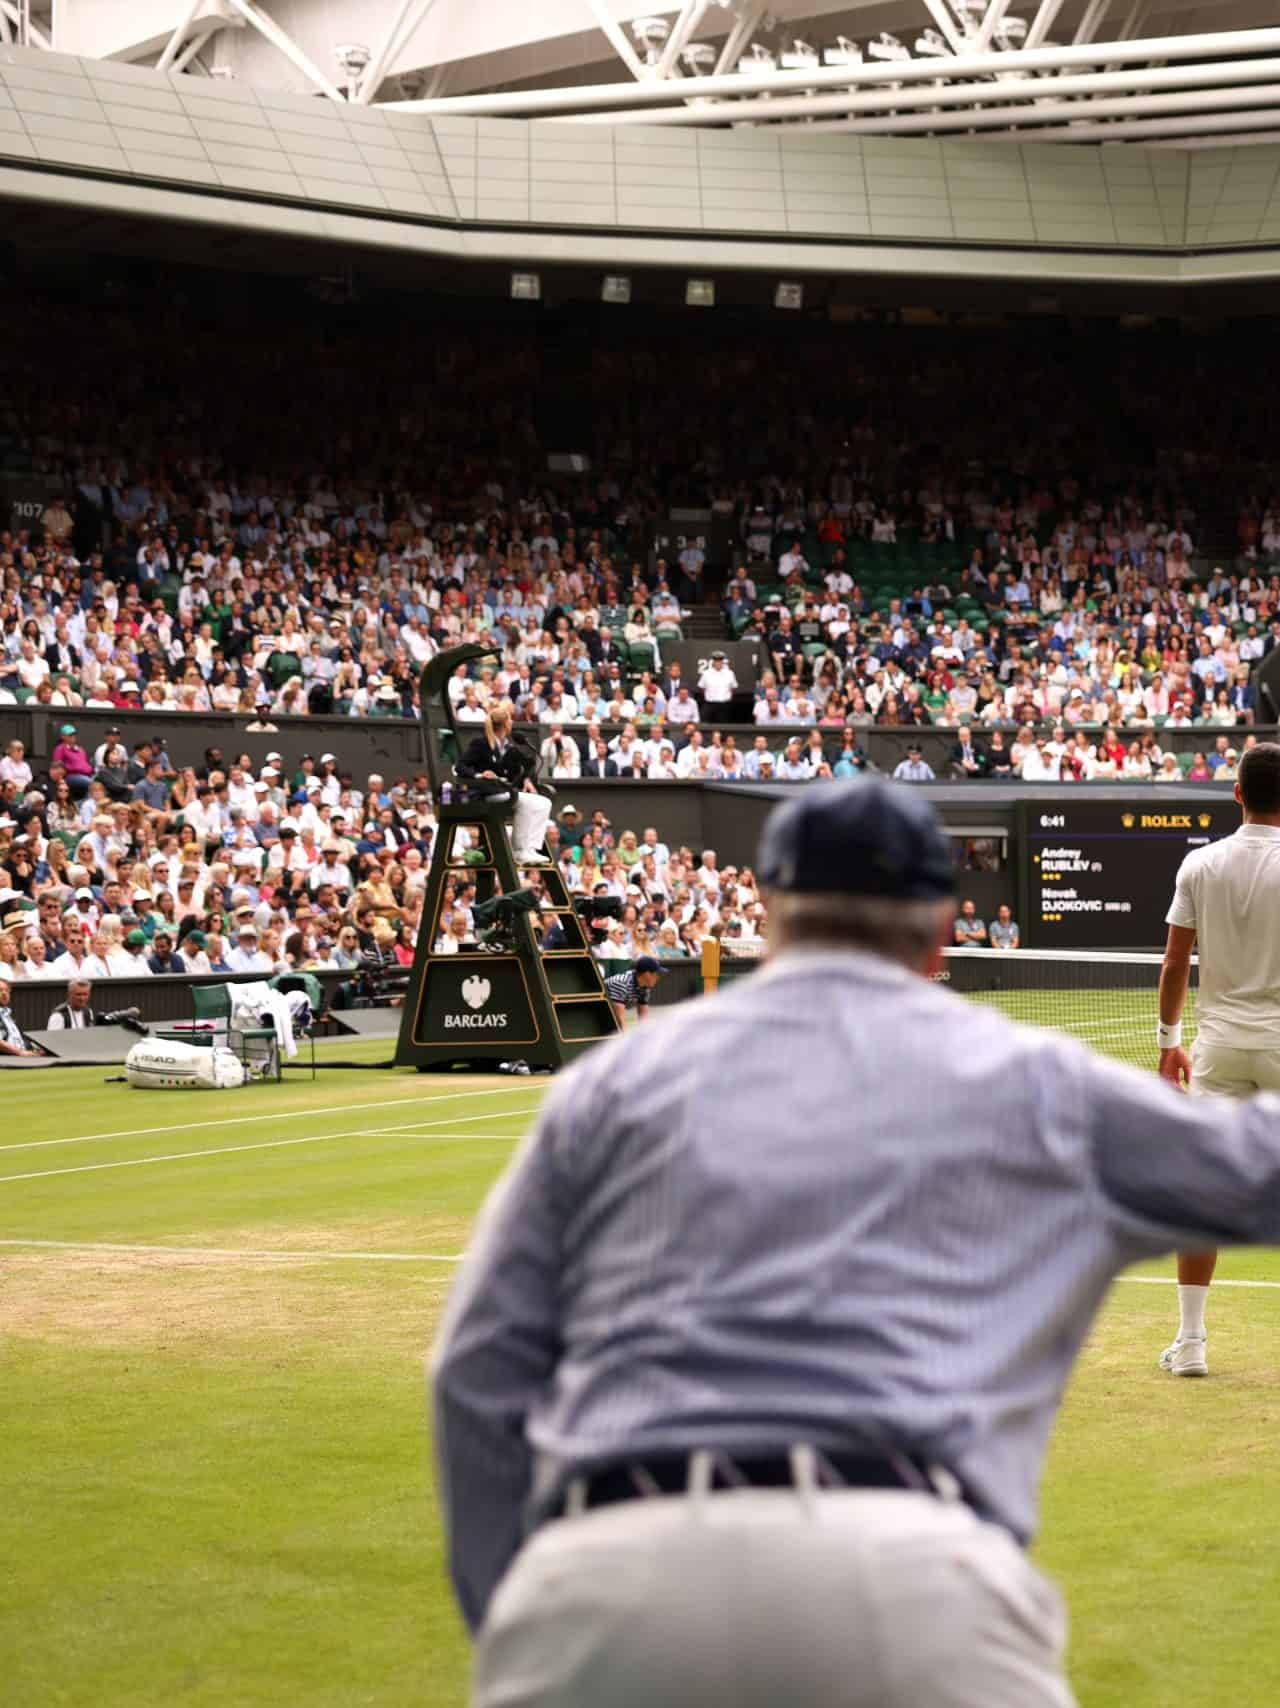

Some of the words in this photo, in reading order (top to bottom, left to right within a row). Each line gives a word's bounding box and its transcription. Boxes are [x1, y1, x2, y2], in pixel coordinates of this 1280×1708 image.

[1040, 815, 1065, 827] 6:41
[1141, 815, 1192, 828] ROLEX
[1041, 848, 1082, 861] Andrey
[1041, 860, 1090, 871] RUBLEV
[1041, 888, 1077, 899] Novak
[1041, 900, 1102, 911] DJOKOVIC
[444, 1013, 508, 1028] BARCLAYS
[134, 1055, 177, 1065] HEAD
